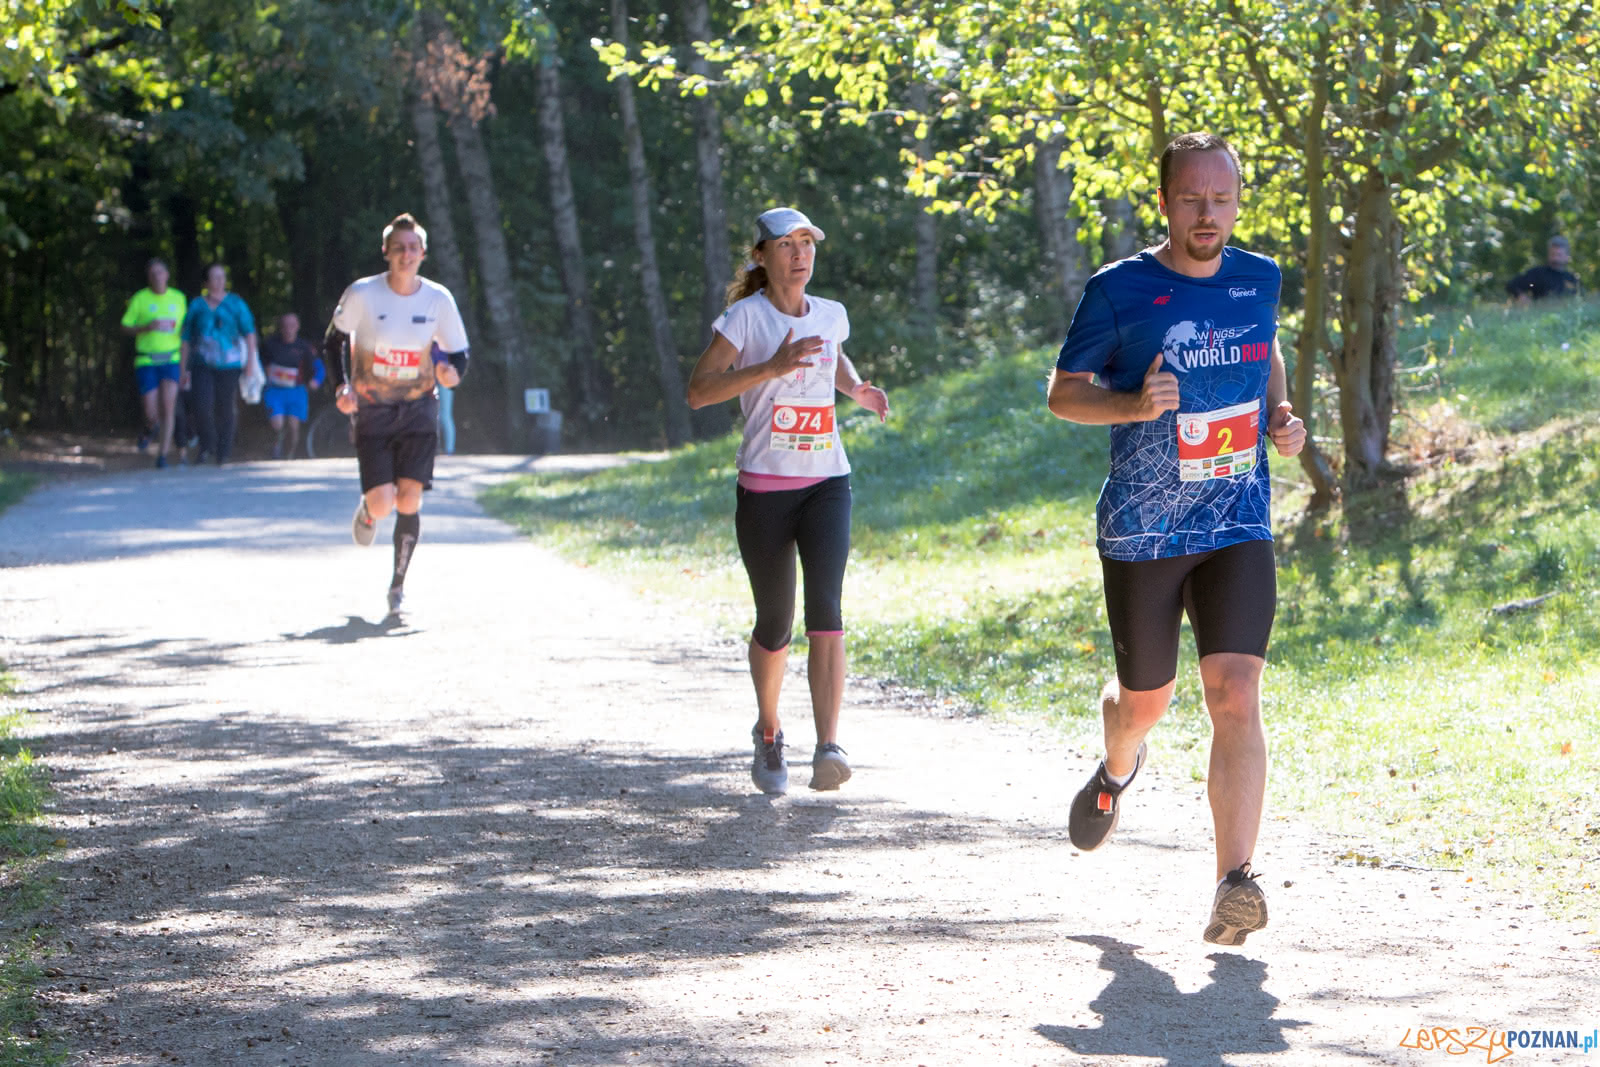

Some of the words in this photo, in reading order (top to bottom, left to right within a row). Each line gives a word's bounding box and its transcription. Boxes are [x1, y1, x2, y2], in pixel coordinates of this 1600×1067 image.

[1197, 328, 1235, 341] WINGS
[1203, 338, 1225, 349] LIFE
[1183, 346, 1241, 369] WORLD
[1241, 342, 1269, 363] RUN
[799, 412, 822, 431] 74
[1217, 427, 1234, 456] 2
